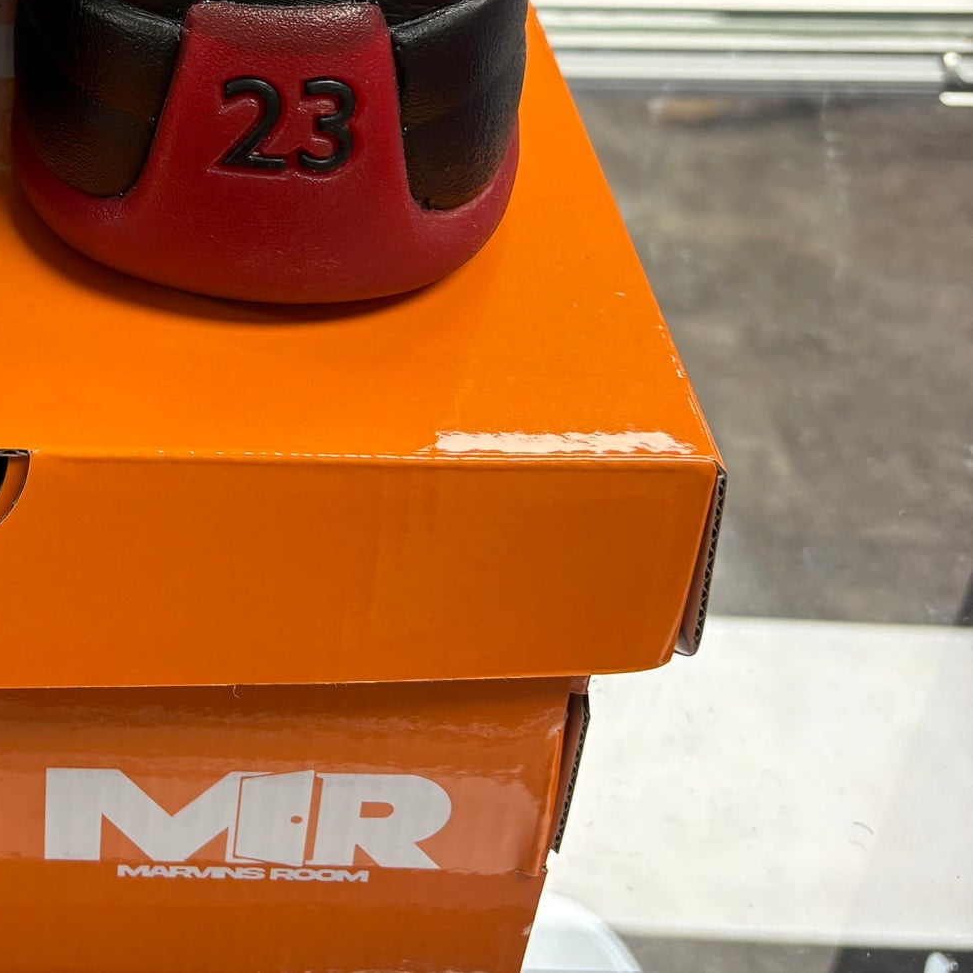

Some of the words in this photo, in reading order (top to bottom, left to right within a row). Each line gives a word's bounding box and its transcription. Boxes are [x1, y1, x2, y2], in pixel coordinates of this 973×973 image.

[223, 78, 356, 172] 23
[117, 863, 265, 881] MARVINS
[270, 866, 369, 883] ROOM
